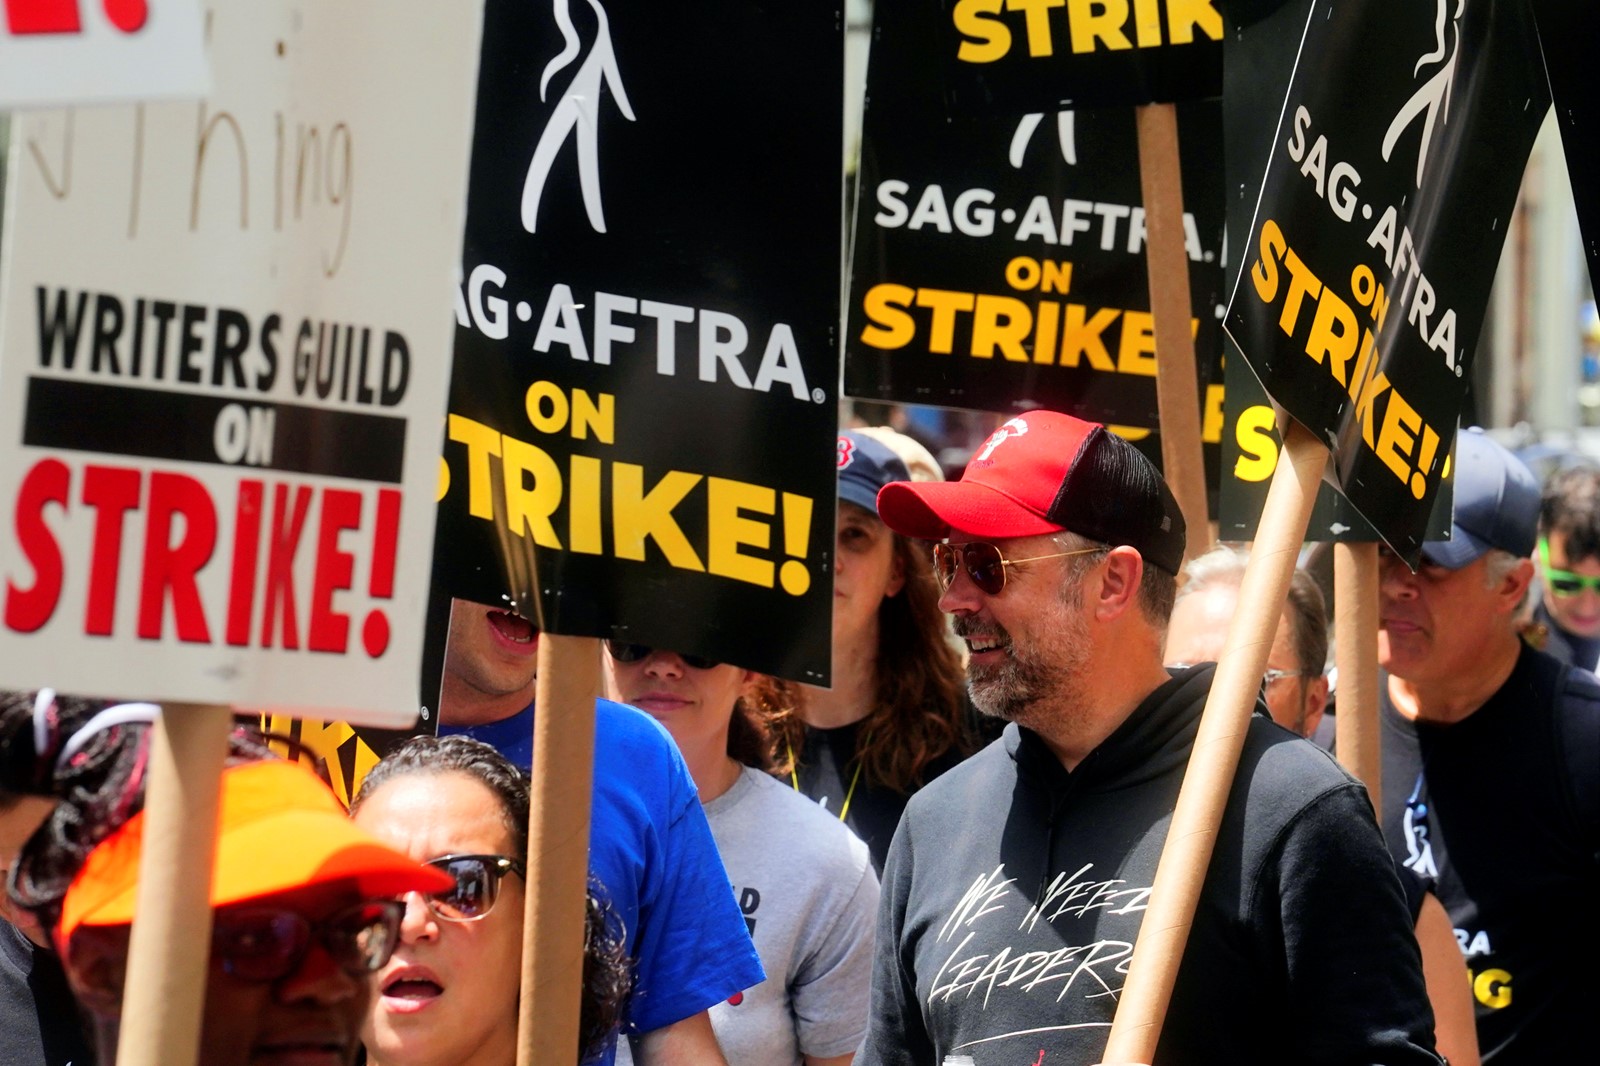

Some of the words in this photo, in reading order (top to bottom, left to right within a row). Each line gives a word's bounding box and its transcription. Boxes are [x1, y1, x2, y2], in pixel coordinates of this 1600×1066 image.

[1005, 256, 1073, 295] ON
[1351, 263, 1391, 334] ON
[35, 285, 281, 393] WRITERS
[293, 317, 411, 407] GUILD
[455, 263, 811, 402] G·AFTRA
[1251, 219, 1440, 500] STRIKE!
[213, 403, 277, 466] ON
[525, 379, 615, 445] ON
[435, 412, 813, 597] TRIKE!
[3, 456, 404, 659] STRIKE!
[936, 863, 1018, 943] WE
